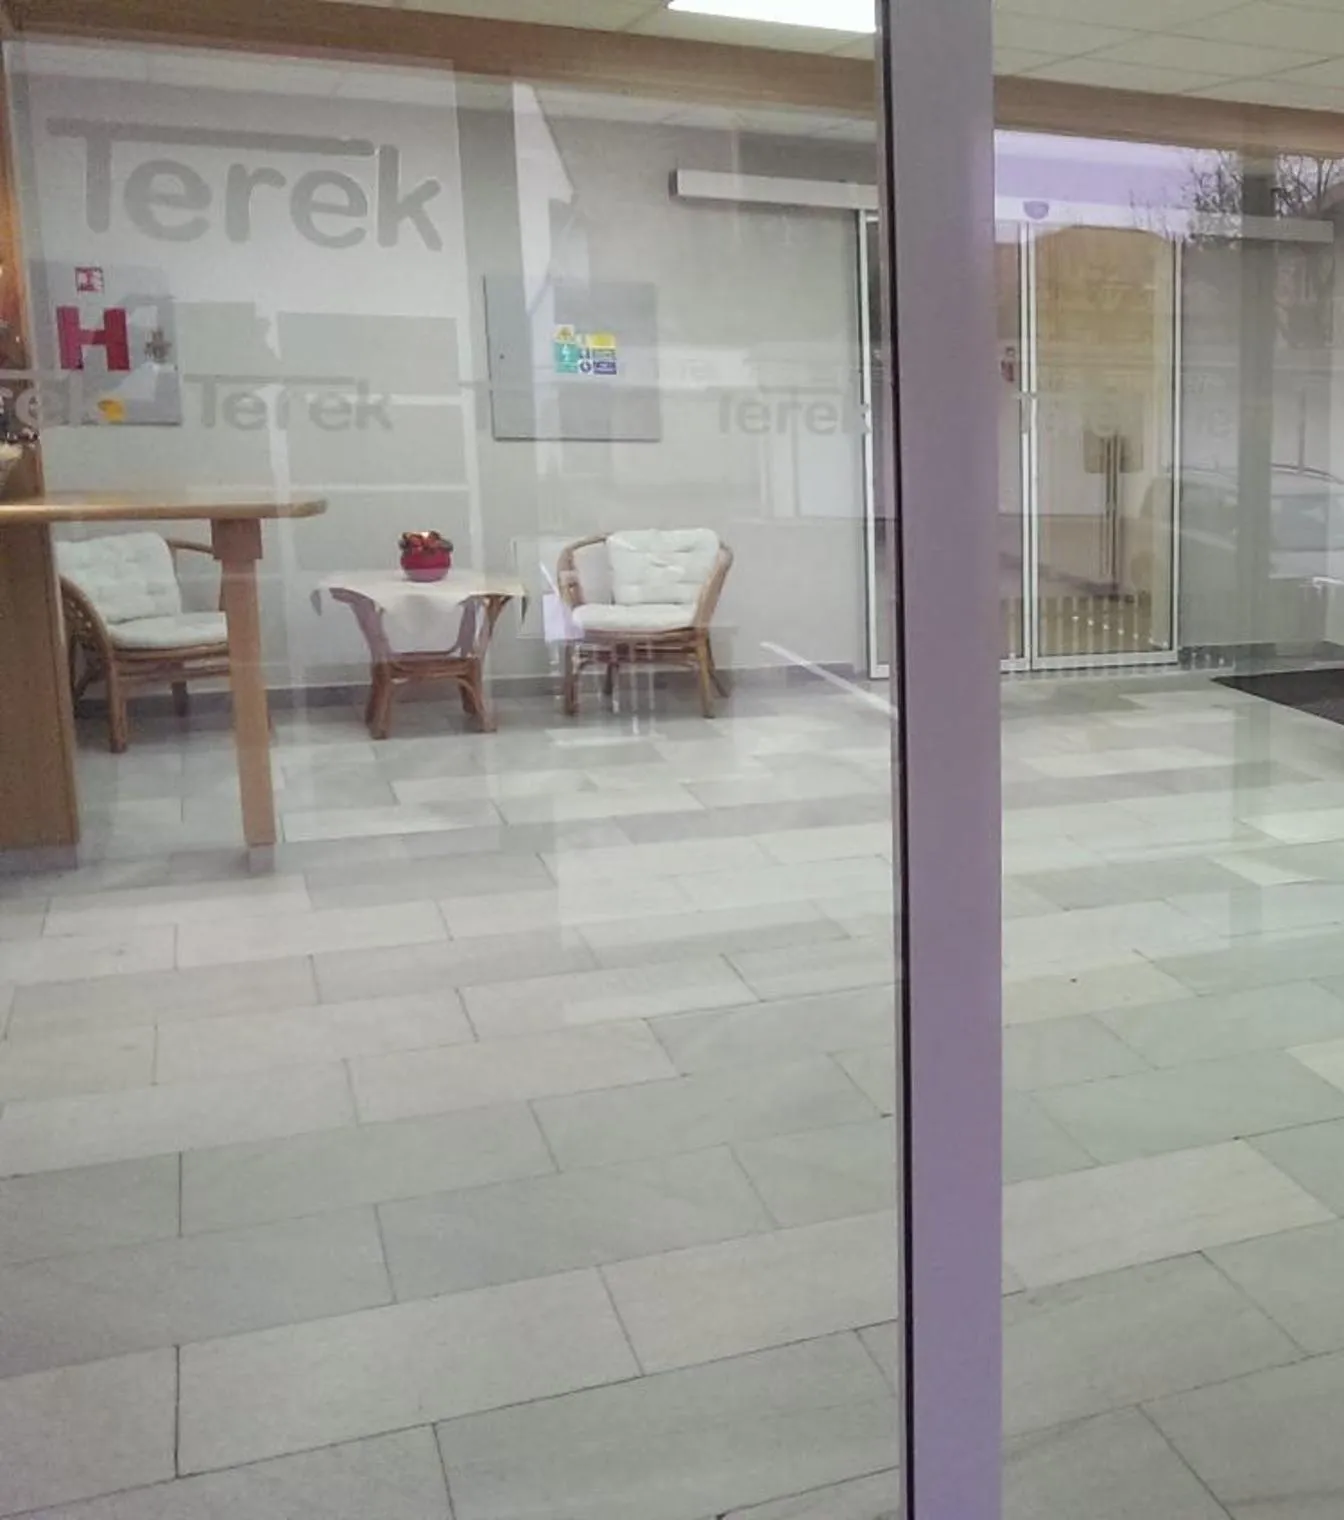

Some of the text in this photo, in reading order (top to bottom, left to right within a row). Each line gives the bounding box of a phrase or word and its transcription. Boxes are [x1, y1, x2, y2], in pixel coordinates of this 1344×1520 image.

[45, 116, 443, 252] Terek
[183, 373, 394, 432] Terek
[705, 384, 872, 436] Terek
